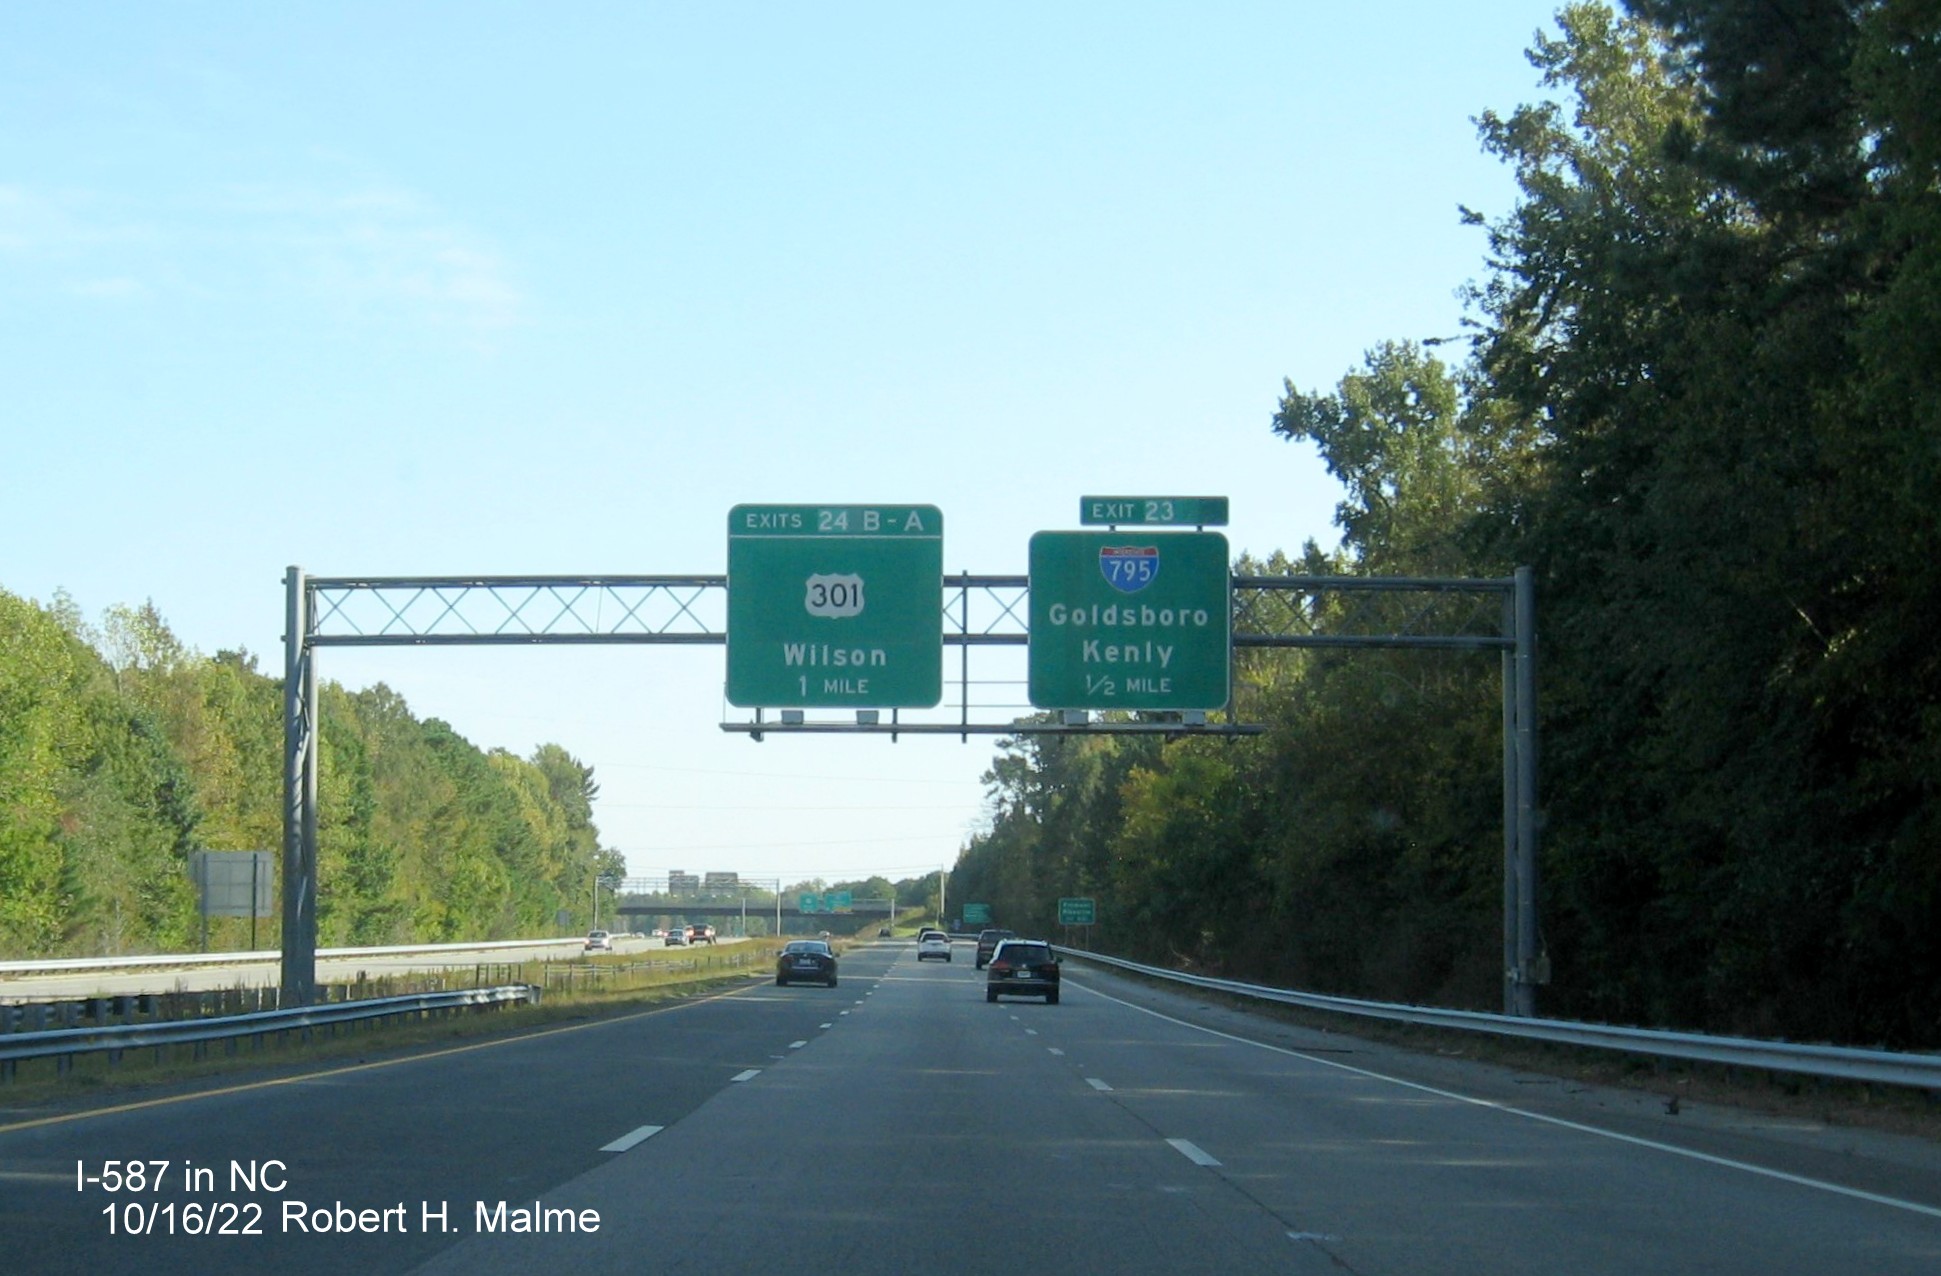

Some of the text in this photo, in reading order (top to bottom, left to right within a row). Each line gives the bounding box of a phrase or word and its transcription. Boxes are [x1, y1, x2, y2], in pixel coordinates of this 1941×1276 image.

[746, 513, 802, 528] EXITS
[818, 511, 848, 530] 24
[1093, 501, 1174, 521] EXIT 23
[1110, 560, 1150, 581] 795
[812, 584, 858, 607] 301
[1049, 603, 1208, 626] Goldsboro
[783, 643, 887, 666] Wilson
[1083, 640, 1173, 667] Kenly
[799, 675, 869, 696] 1 MILE
[1126, 678, 1172, 692] MILE
